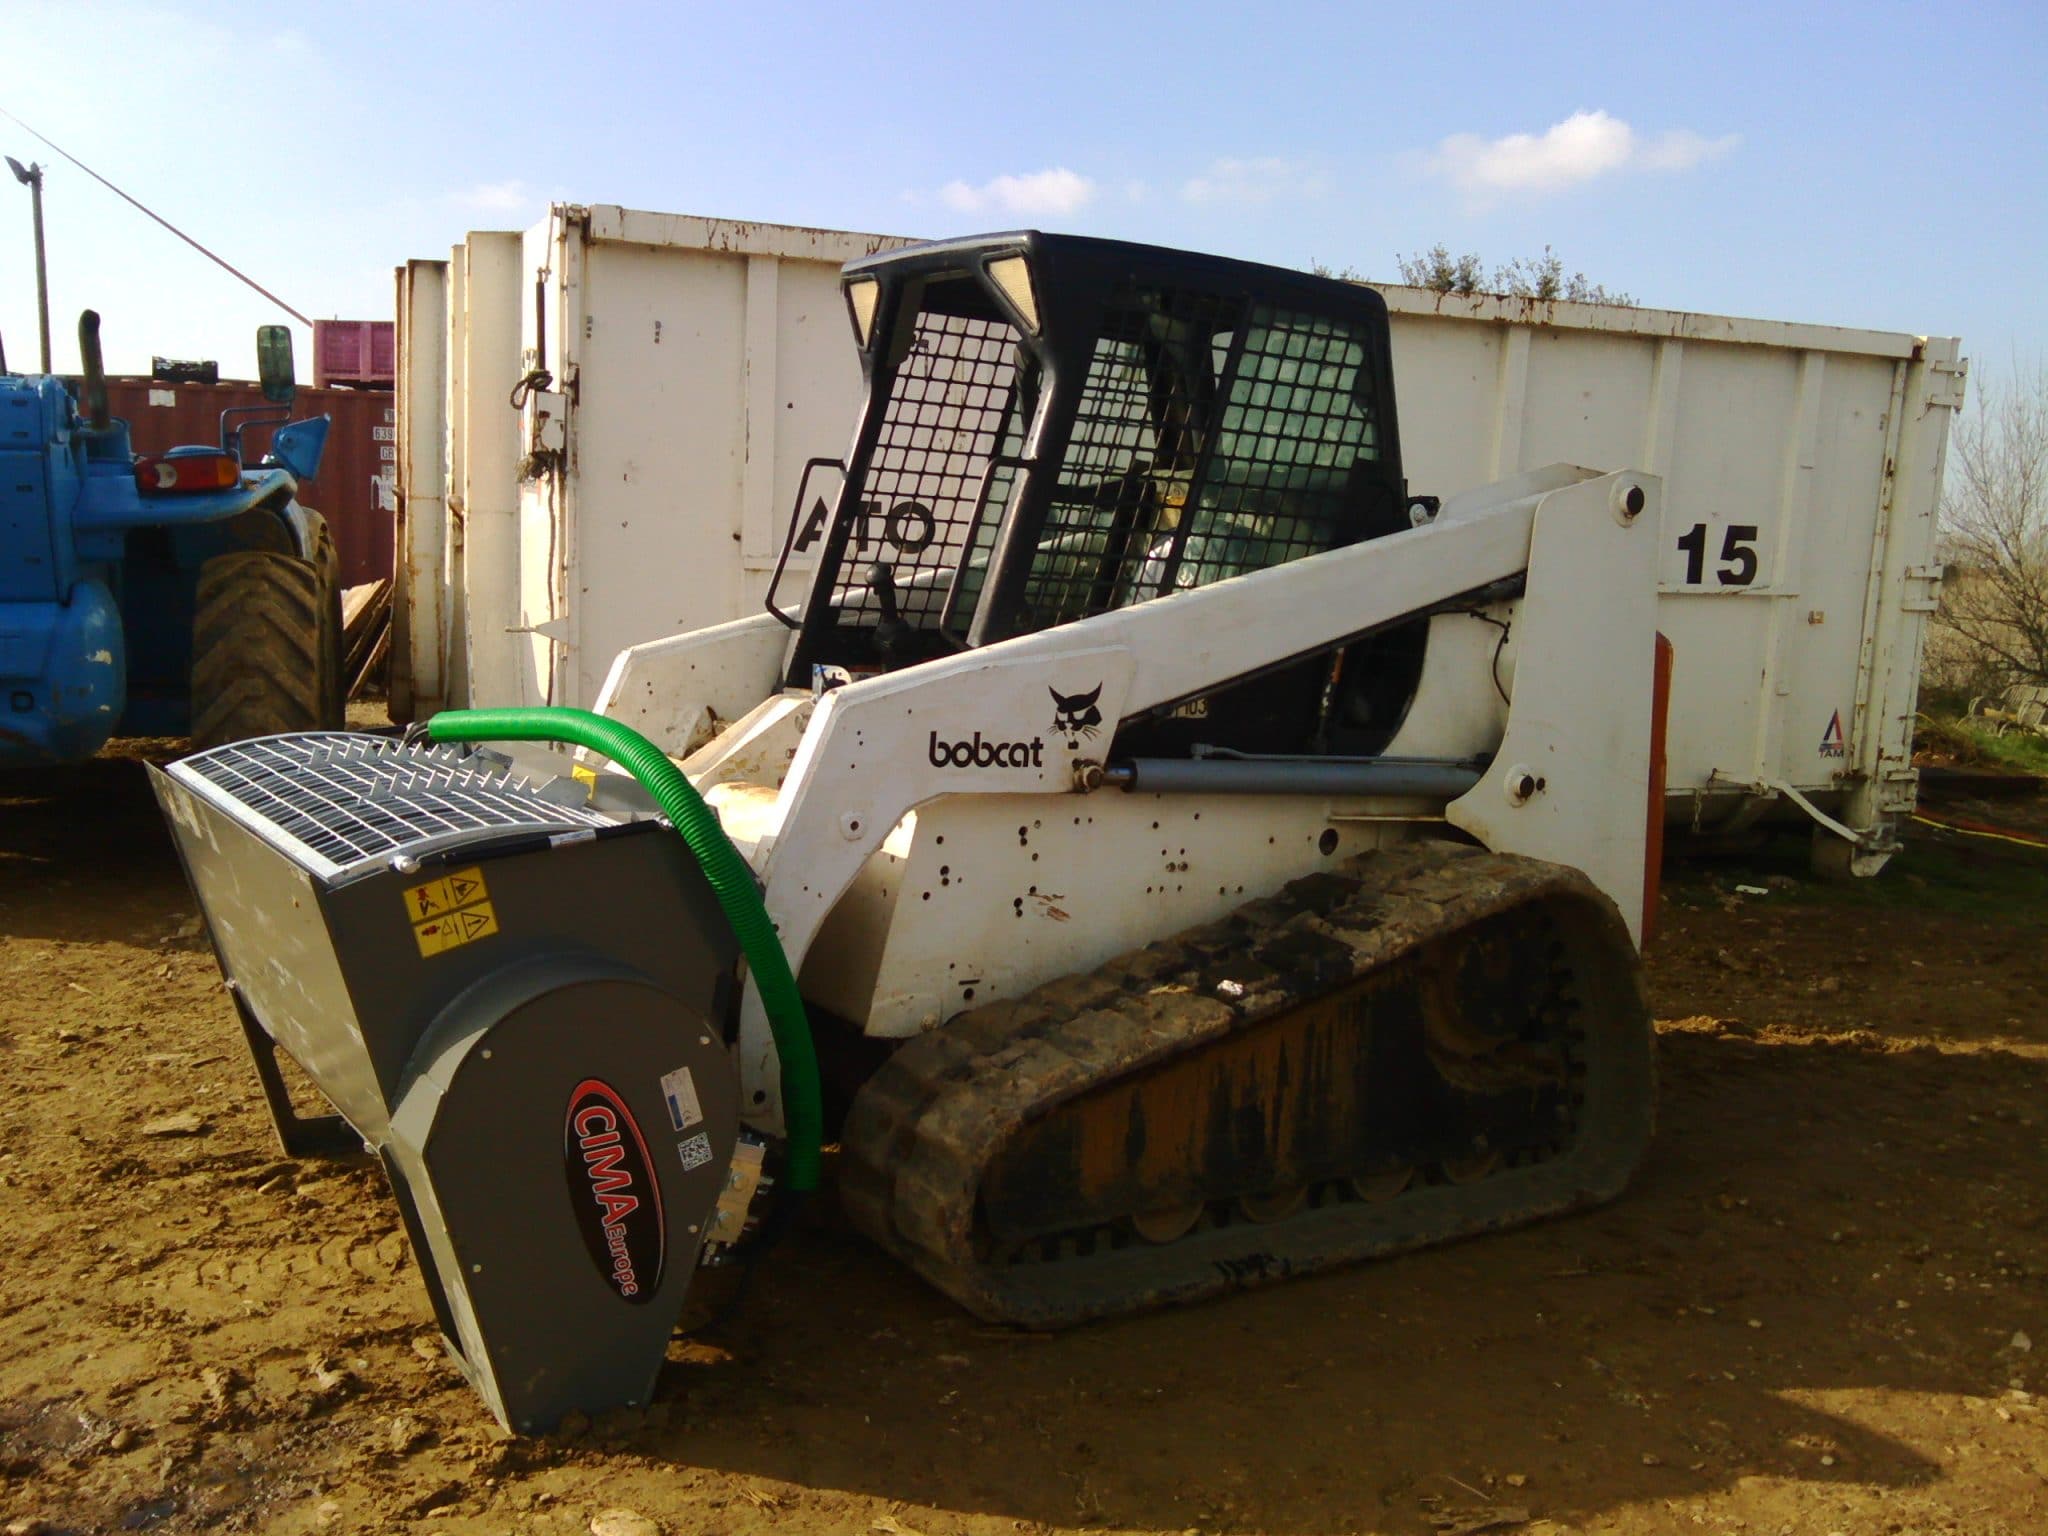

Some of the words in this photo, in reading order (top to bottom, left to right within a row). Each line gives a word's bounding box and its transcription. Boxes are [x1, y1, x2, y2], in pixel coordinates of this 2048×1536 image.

[1677, 523, 1758, 586] 15
[929, 731, 1044, 768] bobcat
[574, 1105, 639, 1227] CIMA
[604, 1222, 639, 1297] Europe
